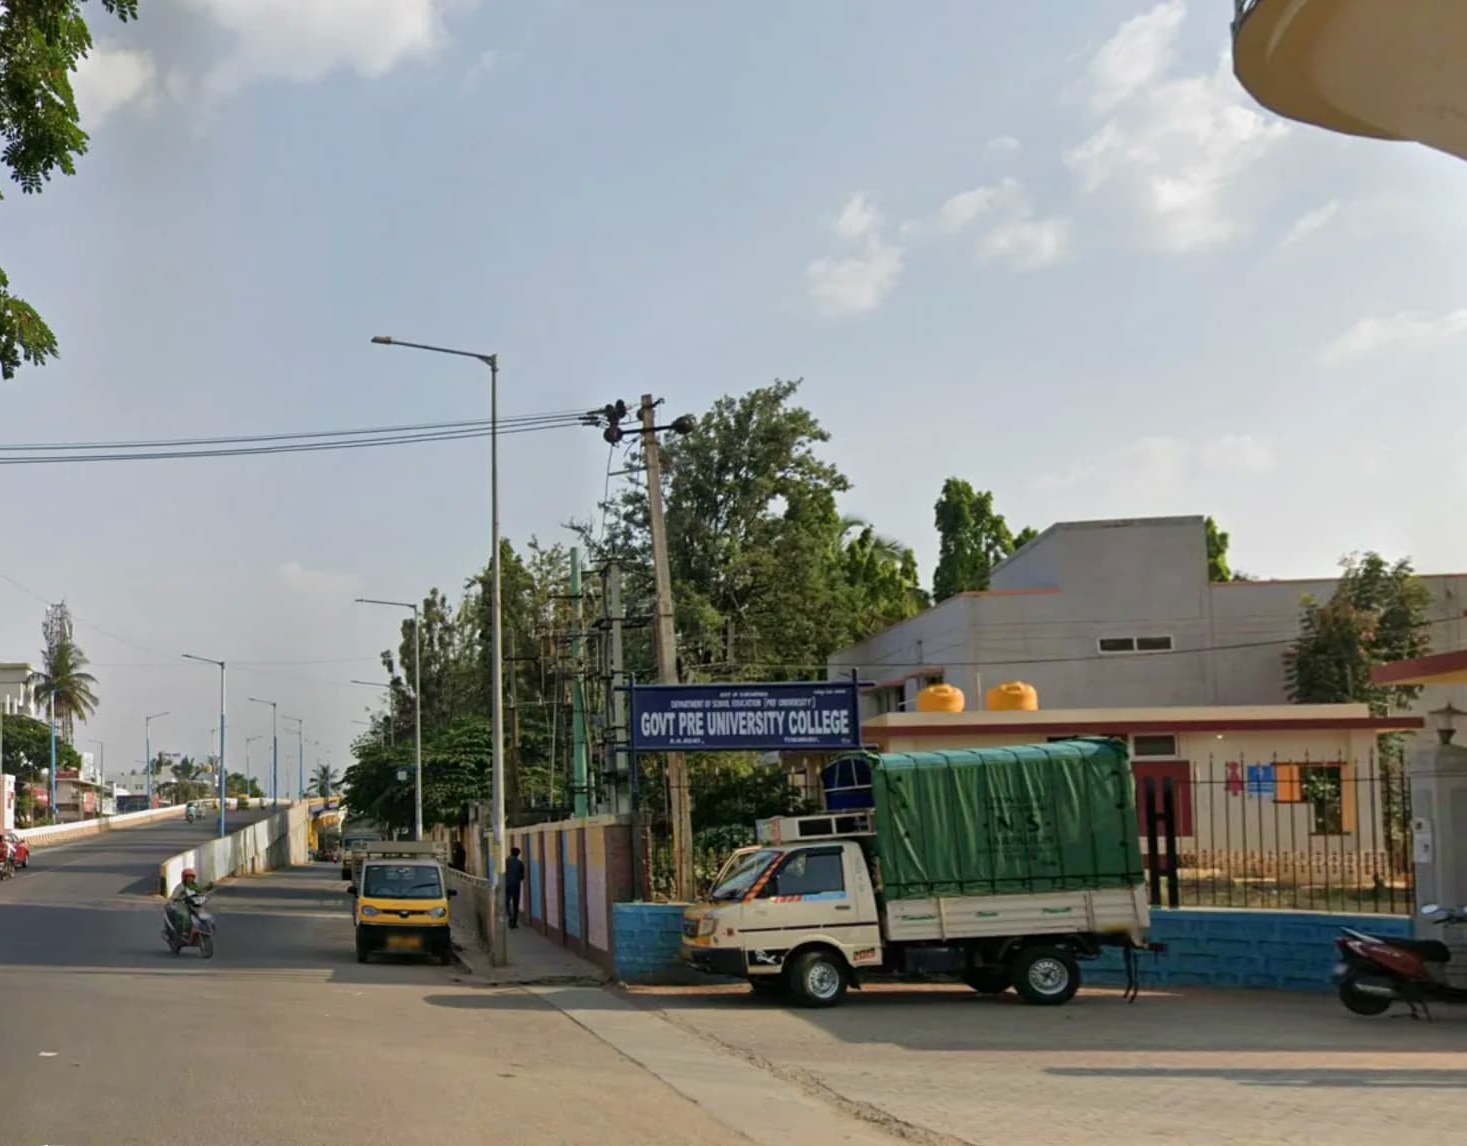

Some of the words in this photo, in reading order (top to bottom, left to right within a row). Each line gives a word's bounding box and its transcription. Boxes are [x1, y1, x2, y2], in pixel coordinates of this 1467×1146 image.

[640, 713, 676, 736] GOVT
[678, 711, 704, 736] PRE
[707, 710, 785, 736] UNIVERSITY
[788, 709, 850, 735] COLLEGE
